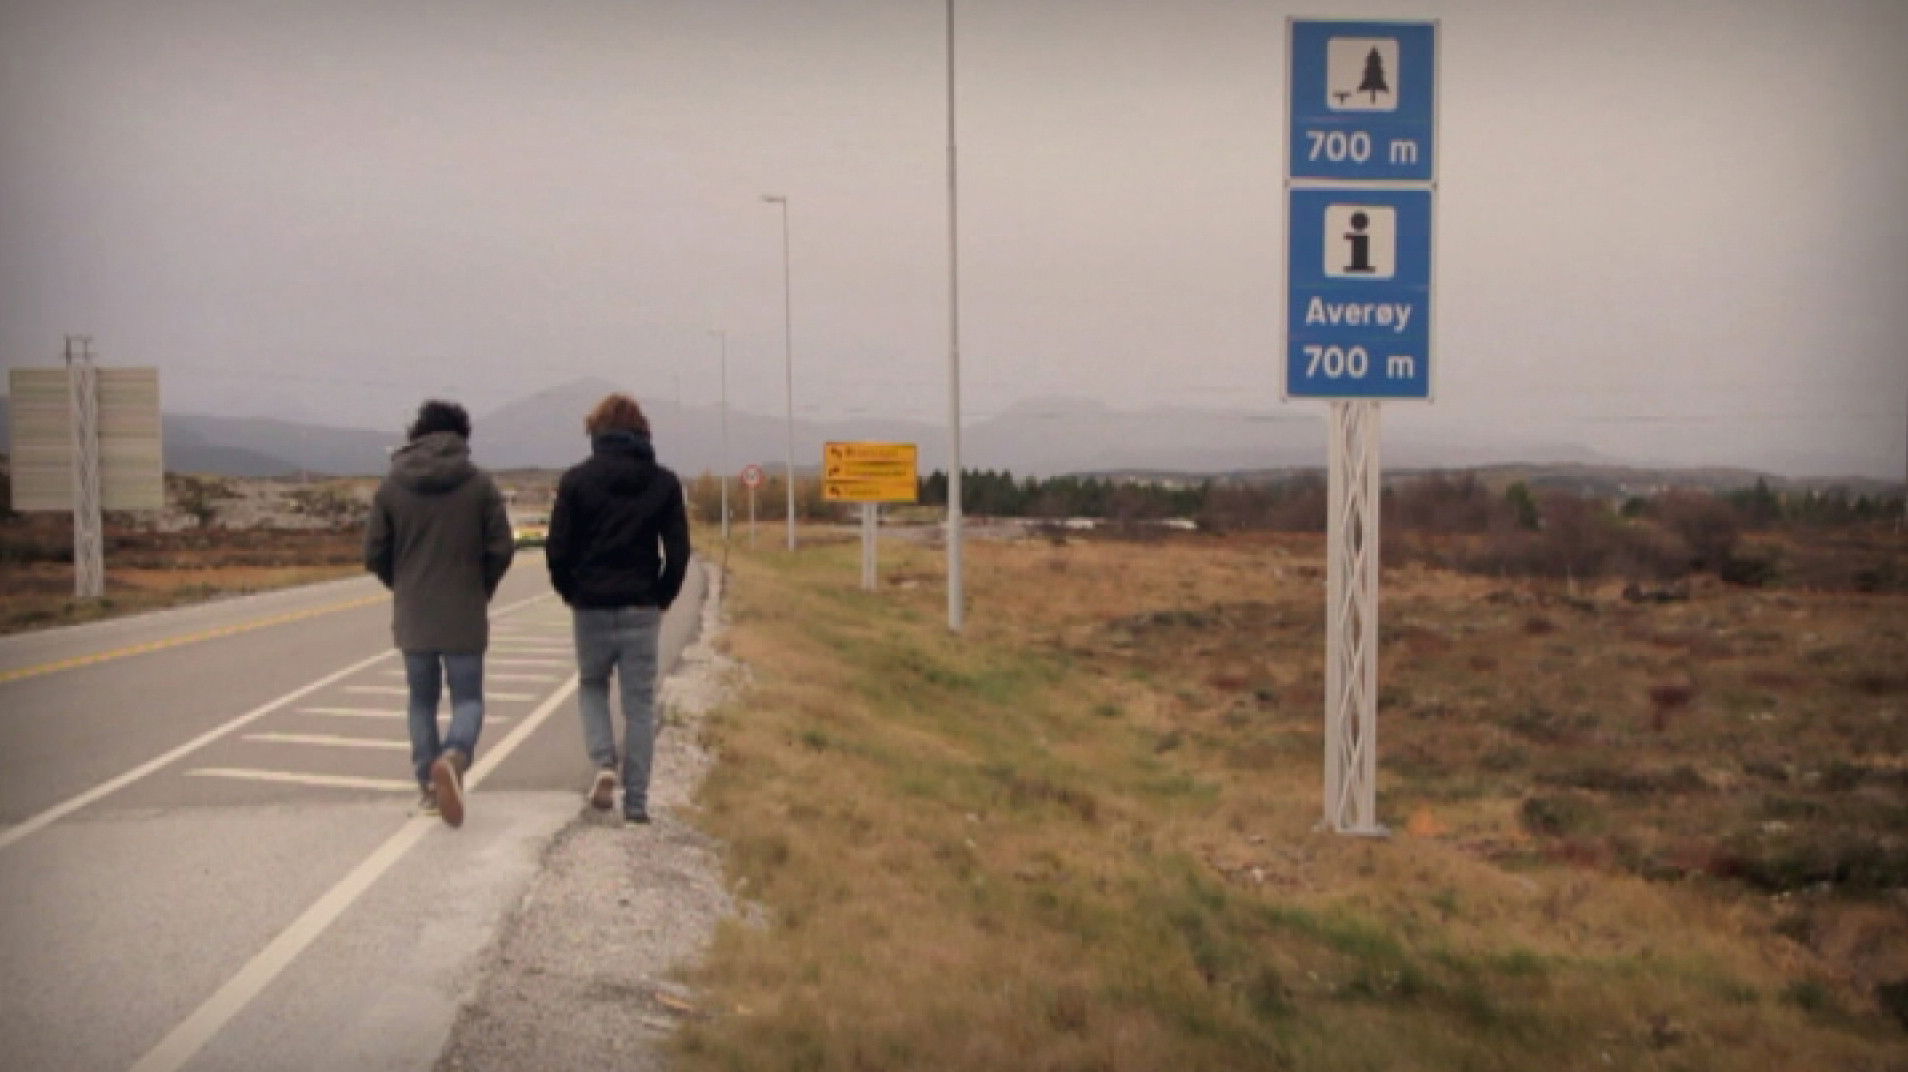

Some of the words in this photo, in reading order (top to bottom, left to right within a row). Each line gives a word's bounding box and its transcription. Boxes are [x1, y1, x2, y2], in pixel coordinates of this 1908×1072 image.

[1306, 130, 1371, 162] 700
[1390, 139, 1418, 164] m
[1303, 346, 1368, 378] 700
[1387, 355, 1414, 379] m
